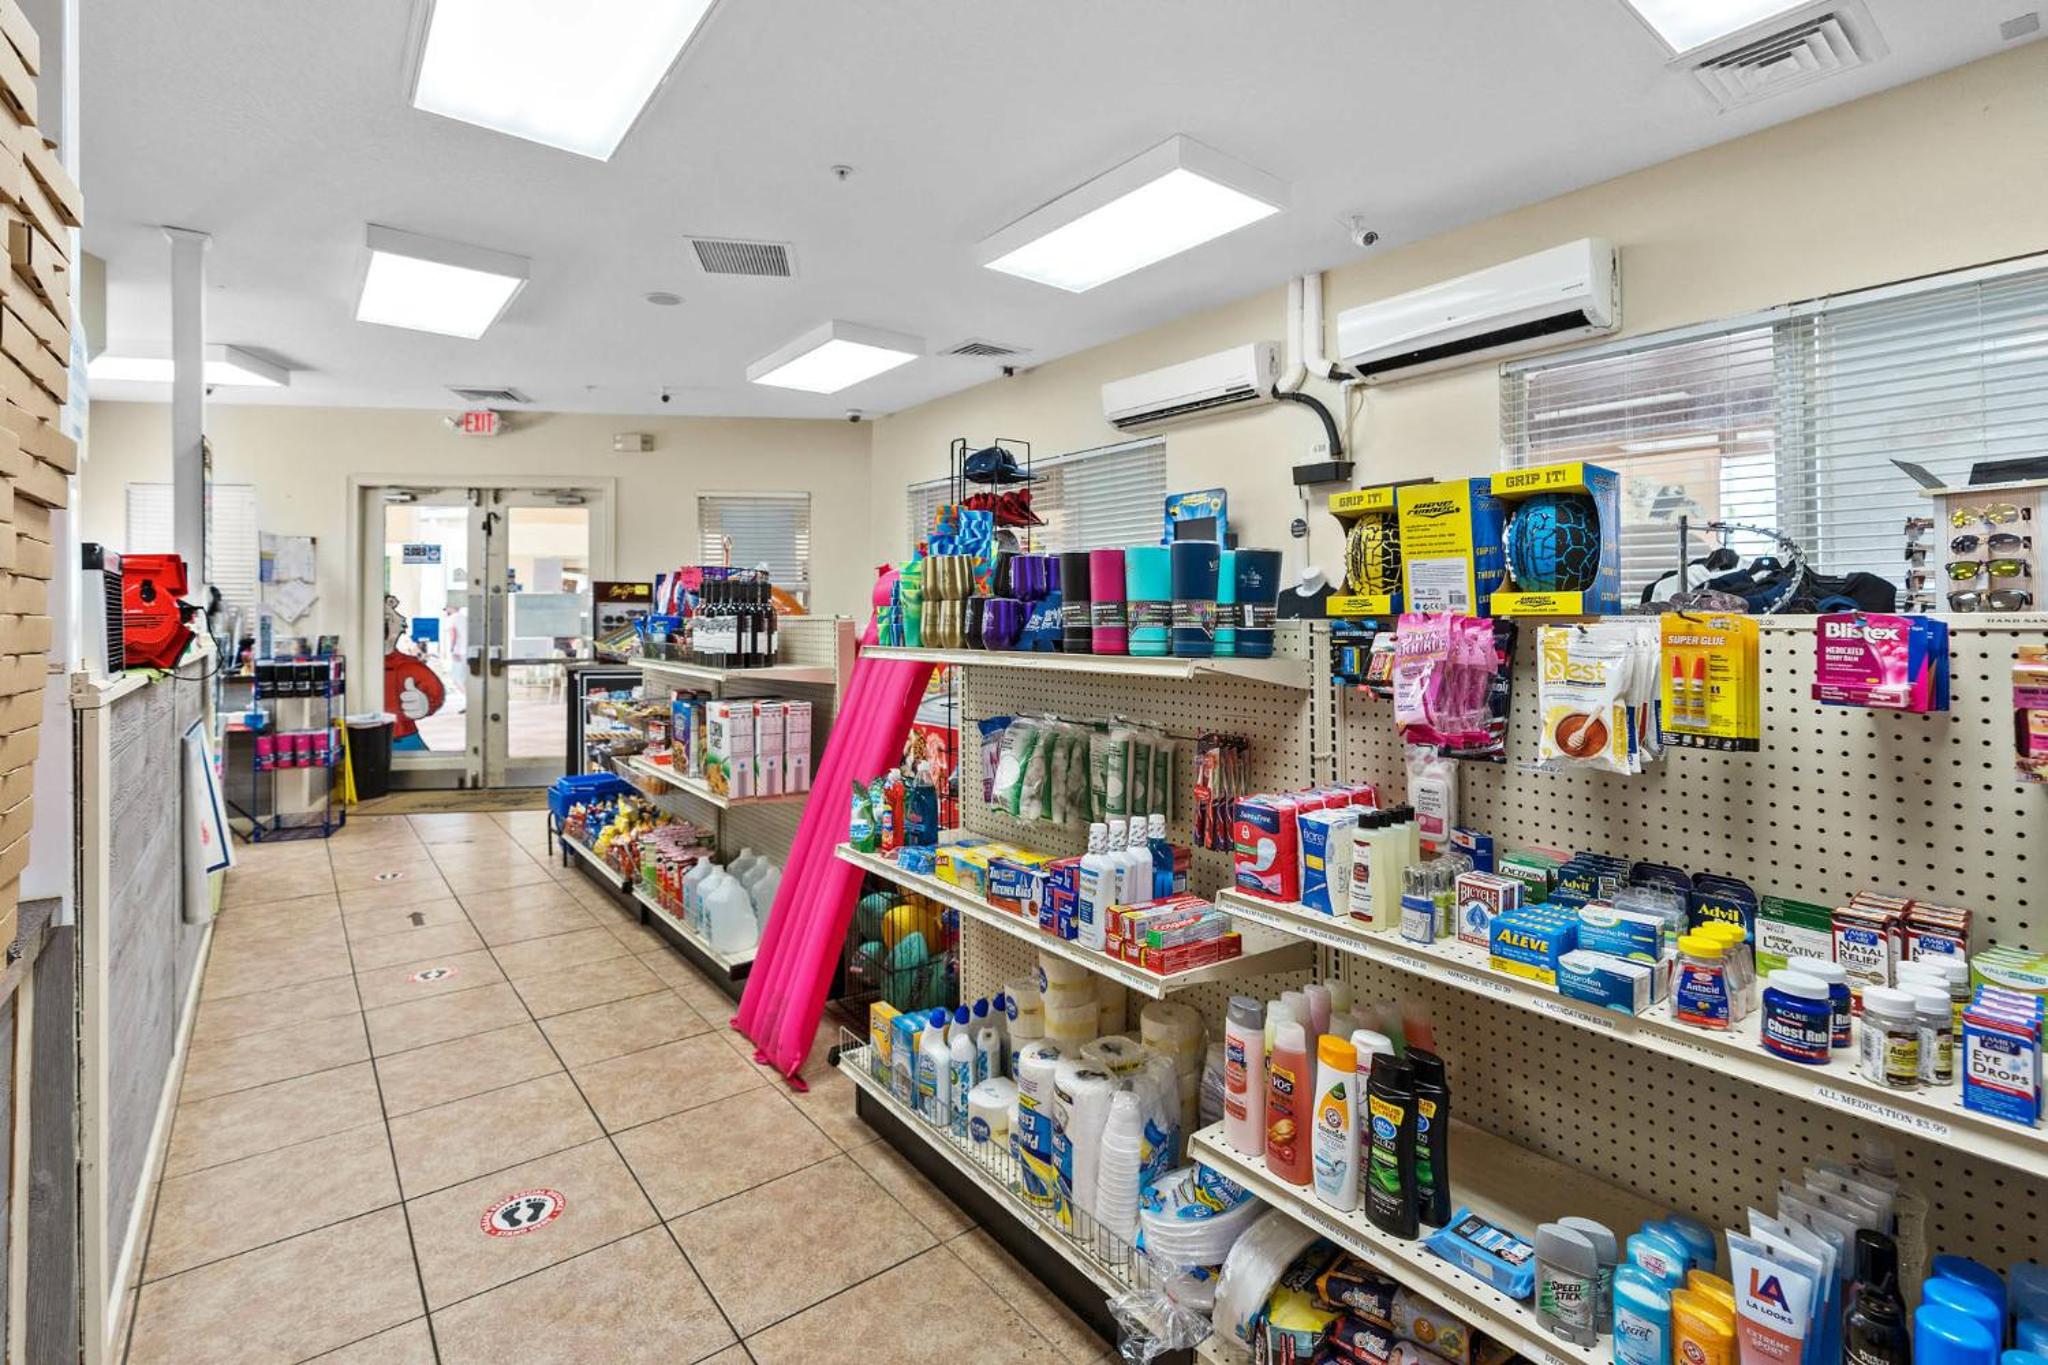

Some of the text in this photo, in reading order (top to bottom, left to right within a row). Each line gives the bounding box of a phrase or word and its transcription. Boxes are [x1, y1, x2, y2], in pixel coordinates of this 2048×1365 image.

[464, 412, 494, 433] EXIT
[1506, 470, 1566, 487] GRIP IT!
[1339, 492, 1382, 507] GRIP IT!
[1667, 635, 1726, 646] SUPER GLUE
[1825, 621, 1901, 645] Blistex
[1825, 646, 1865, 656] MEDICATED
[1459, 882, 1499, 905] BICYCLE
[1561, 878, 1589, 892] Advil
[1697, 903, 1740, 922] Advil
[1496, 929, 1550, 953] ALEVE
[1845, 929, 1876, 940] FAMILY
[1918, 936, 1951, 948] FAMILY
[1763, 936, 1825, 959] LAXATIVE
[1838, 941, 1885, 958] NASAL
[1839, 950, 1881, 966] RELIEF
[1686, 982, 1720, 995] Antacid
[1767, 1018, 1828, 1043] Chest Rub
[1972, 1049, 2002, 1066] EYE
[1972, 1061, 2029, 1087] DROPS
[1817, 1088, 1947, 1136] ALL MEDICATION $3.99
[1551, 1280, 1581, 1292] SPEED
[1750, 1267, 1791, 1313] LA
[1554, 1291, 1582, 1301] STICK
[1745, 1299, 1795, 1326] LA LOOKS
[1620, 1319, 1653, 1342] Secret
